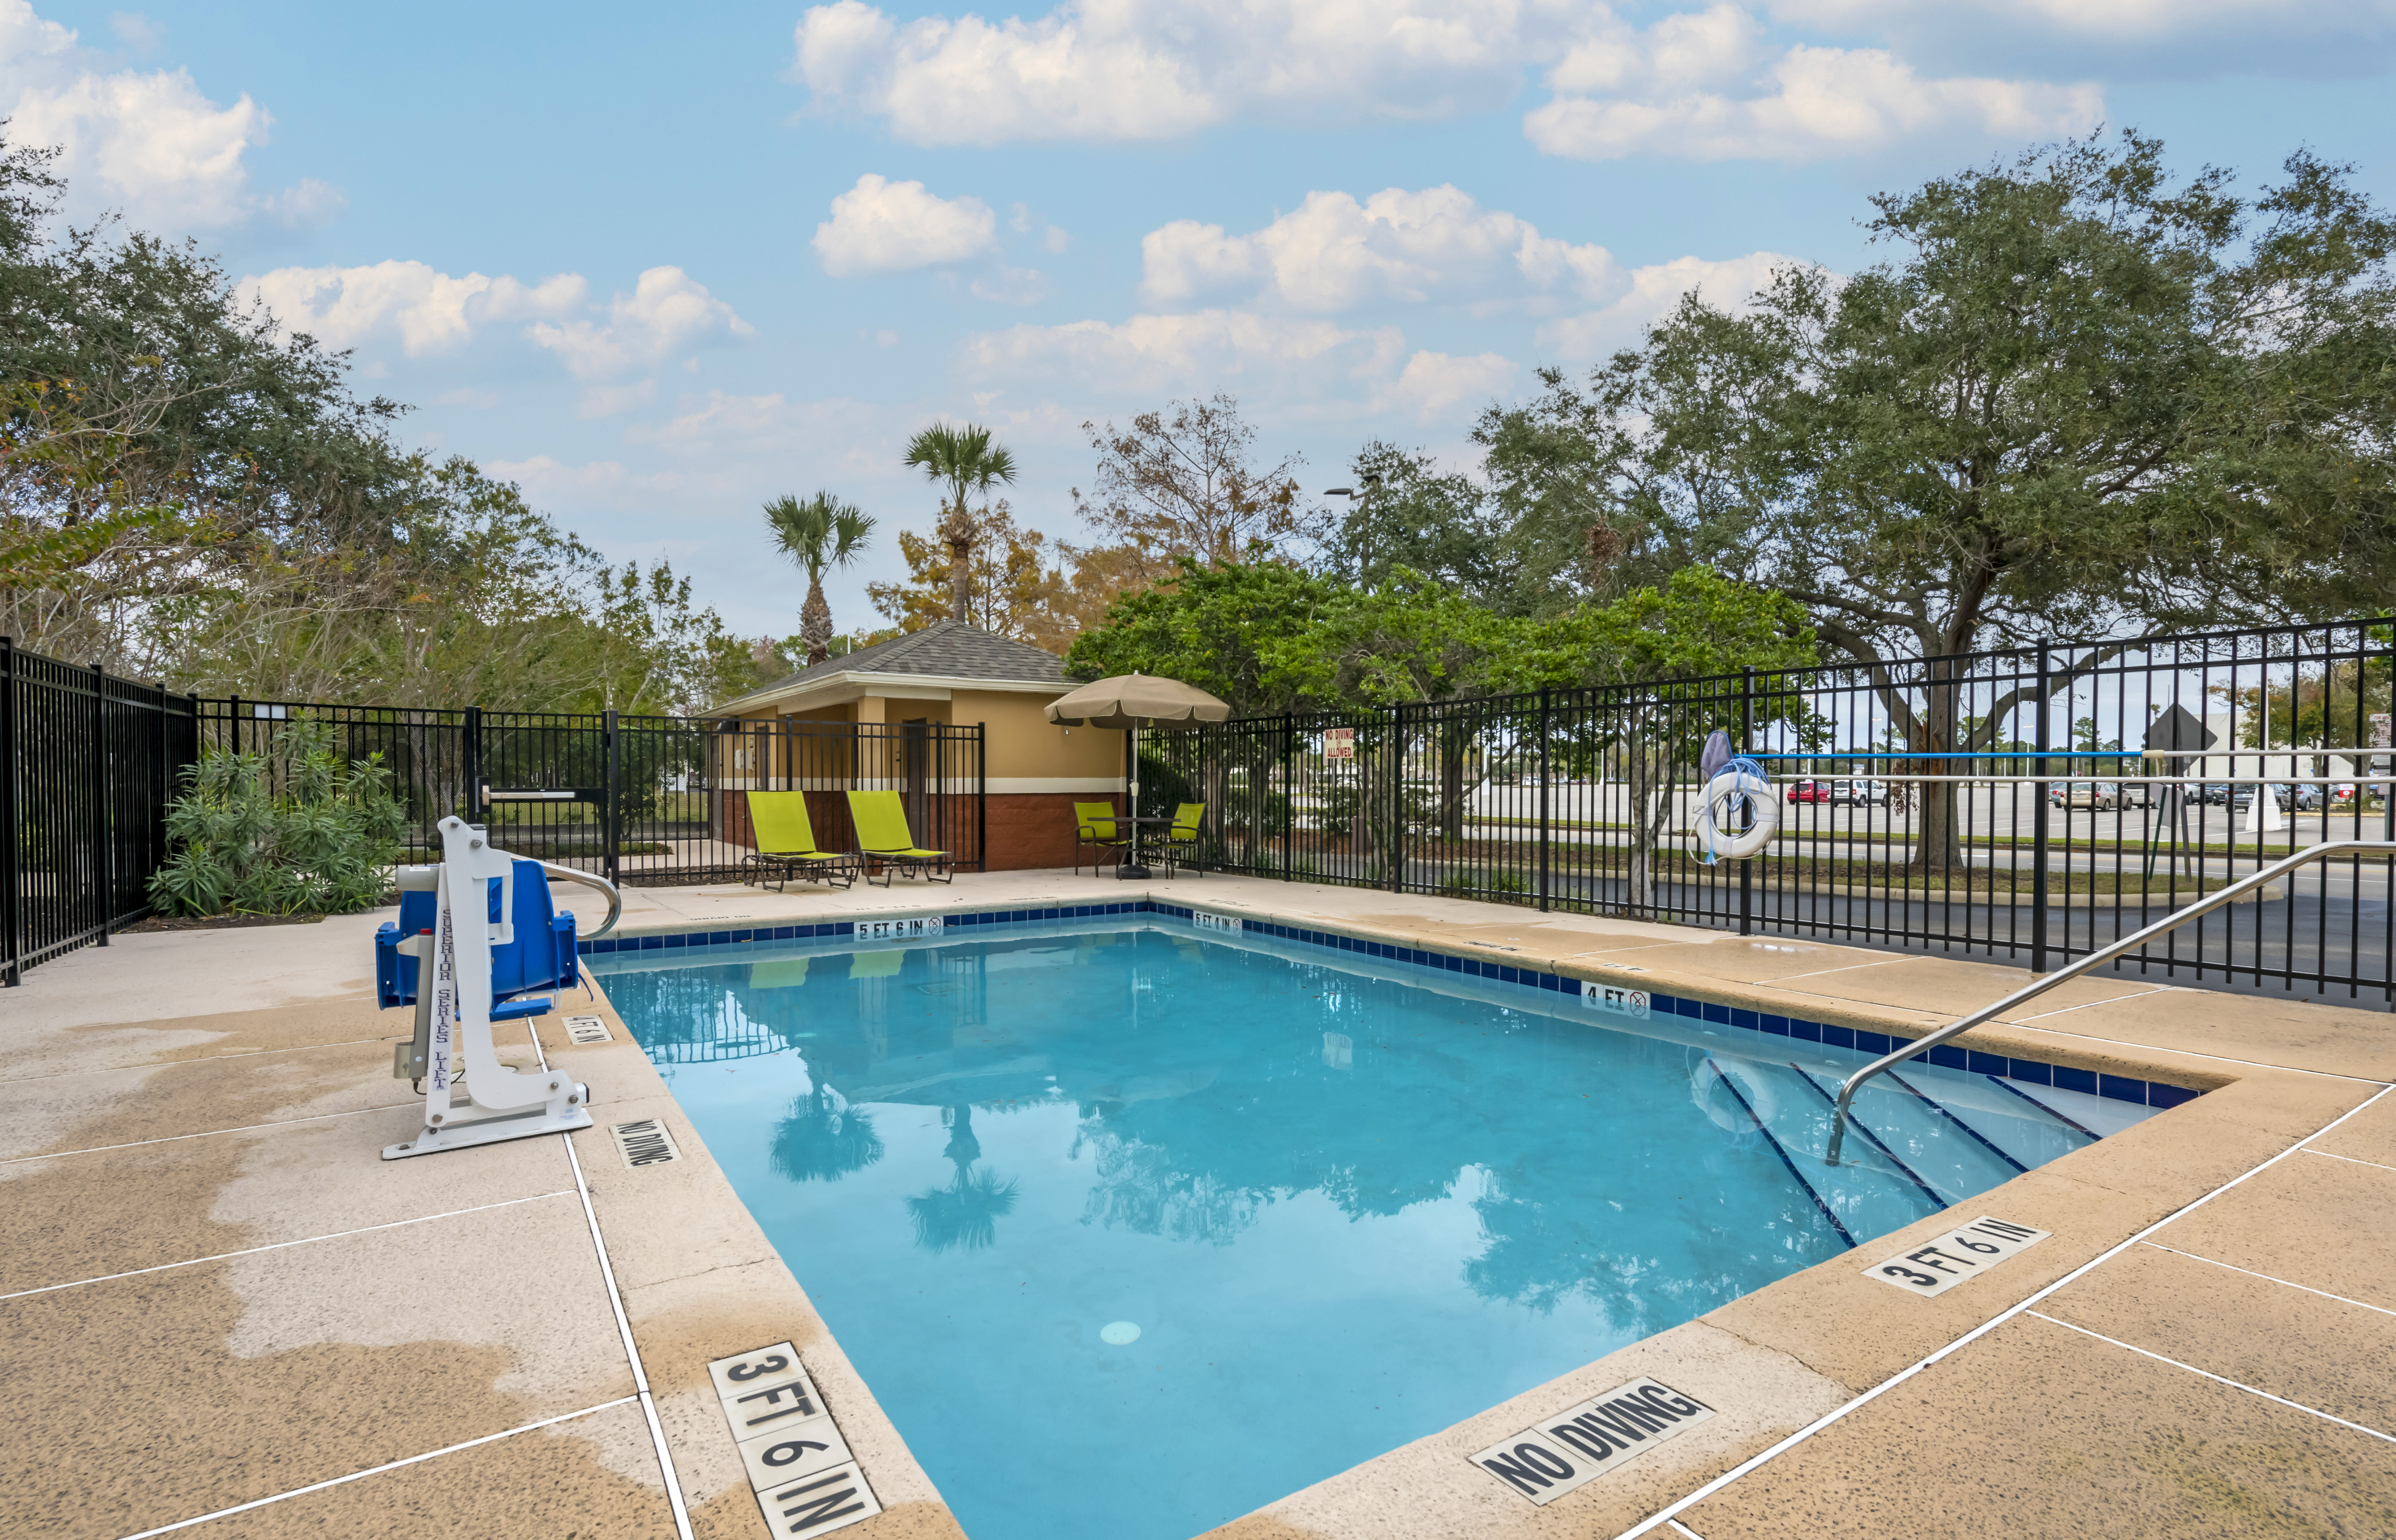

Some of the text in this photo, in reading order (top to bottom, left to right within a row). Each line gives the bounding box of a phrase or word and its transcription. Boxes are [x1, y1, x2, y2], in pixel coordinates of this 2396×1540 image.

[1326, 729, 1353, 740] NO DIVING
[1328, 747, 1351, 757] ALLOWED
[440, 909, 453, 980] SUPERIOR
[436, 989, 450, 1043] SERIES
[577, 1034, 606, 1043] IN
[435, 1051, 447, 1087] LIFT
[616, 1120, 673, 1166] NO DIVING
[1883, 1219, 2037, 1286] 3 FT 6 IN
[727, 1355, 866, 1533] 3 FT 6 IN
[1481, 1385, 1703, 1496] NO DIVING
